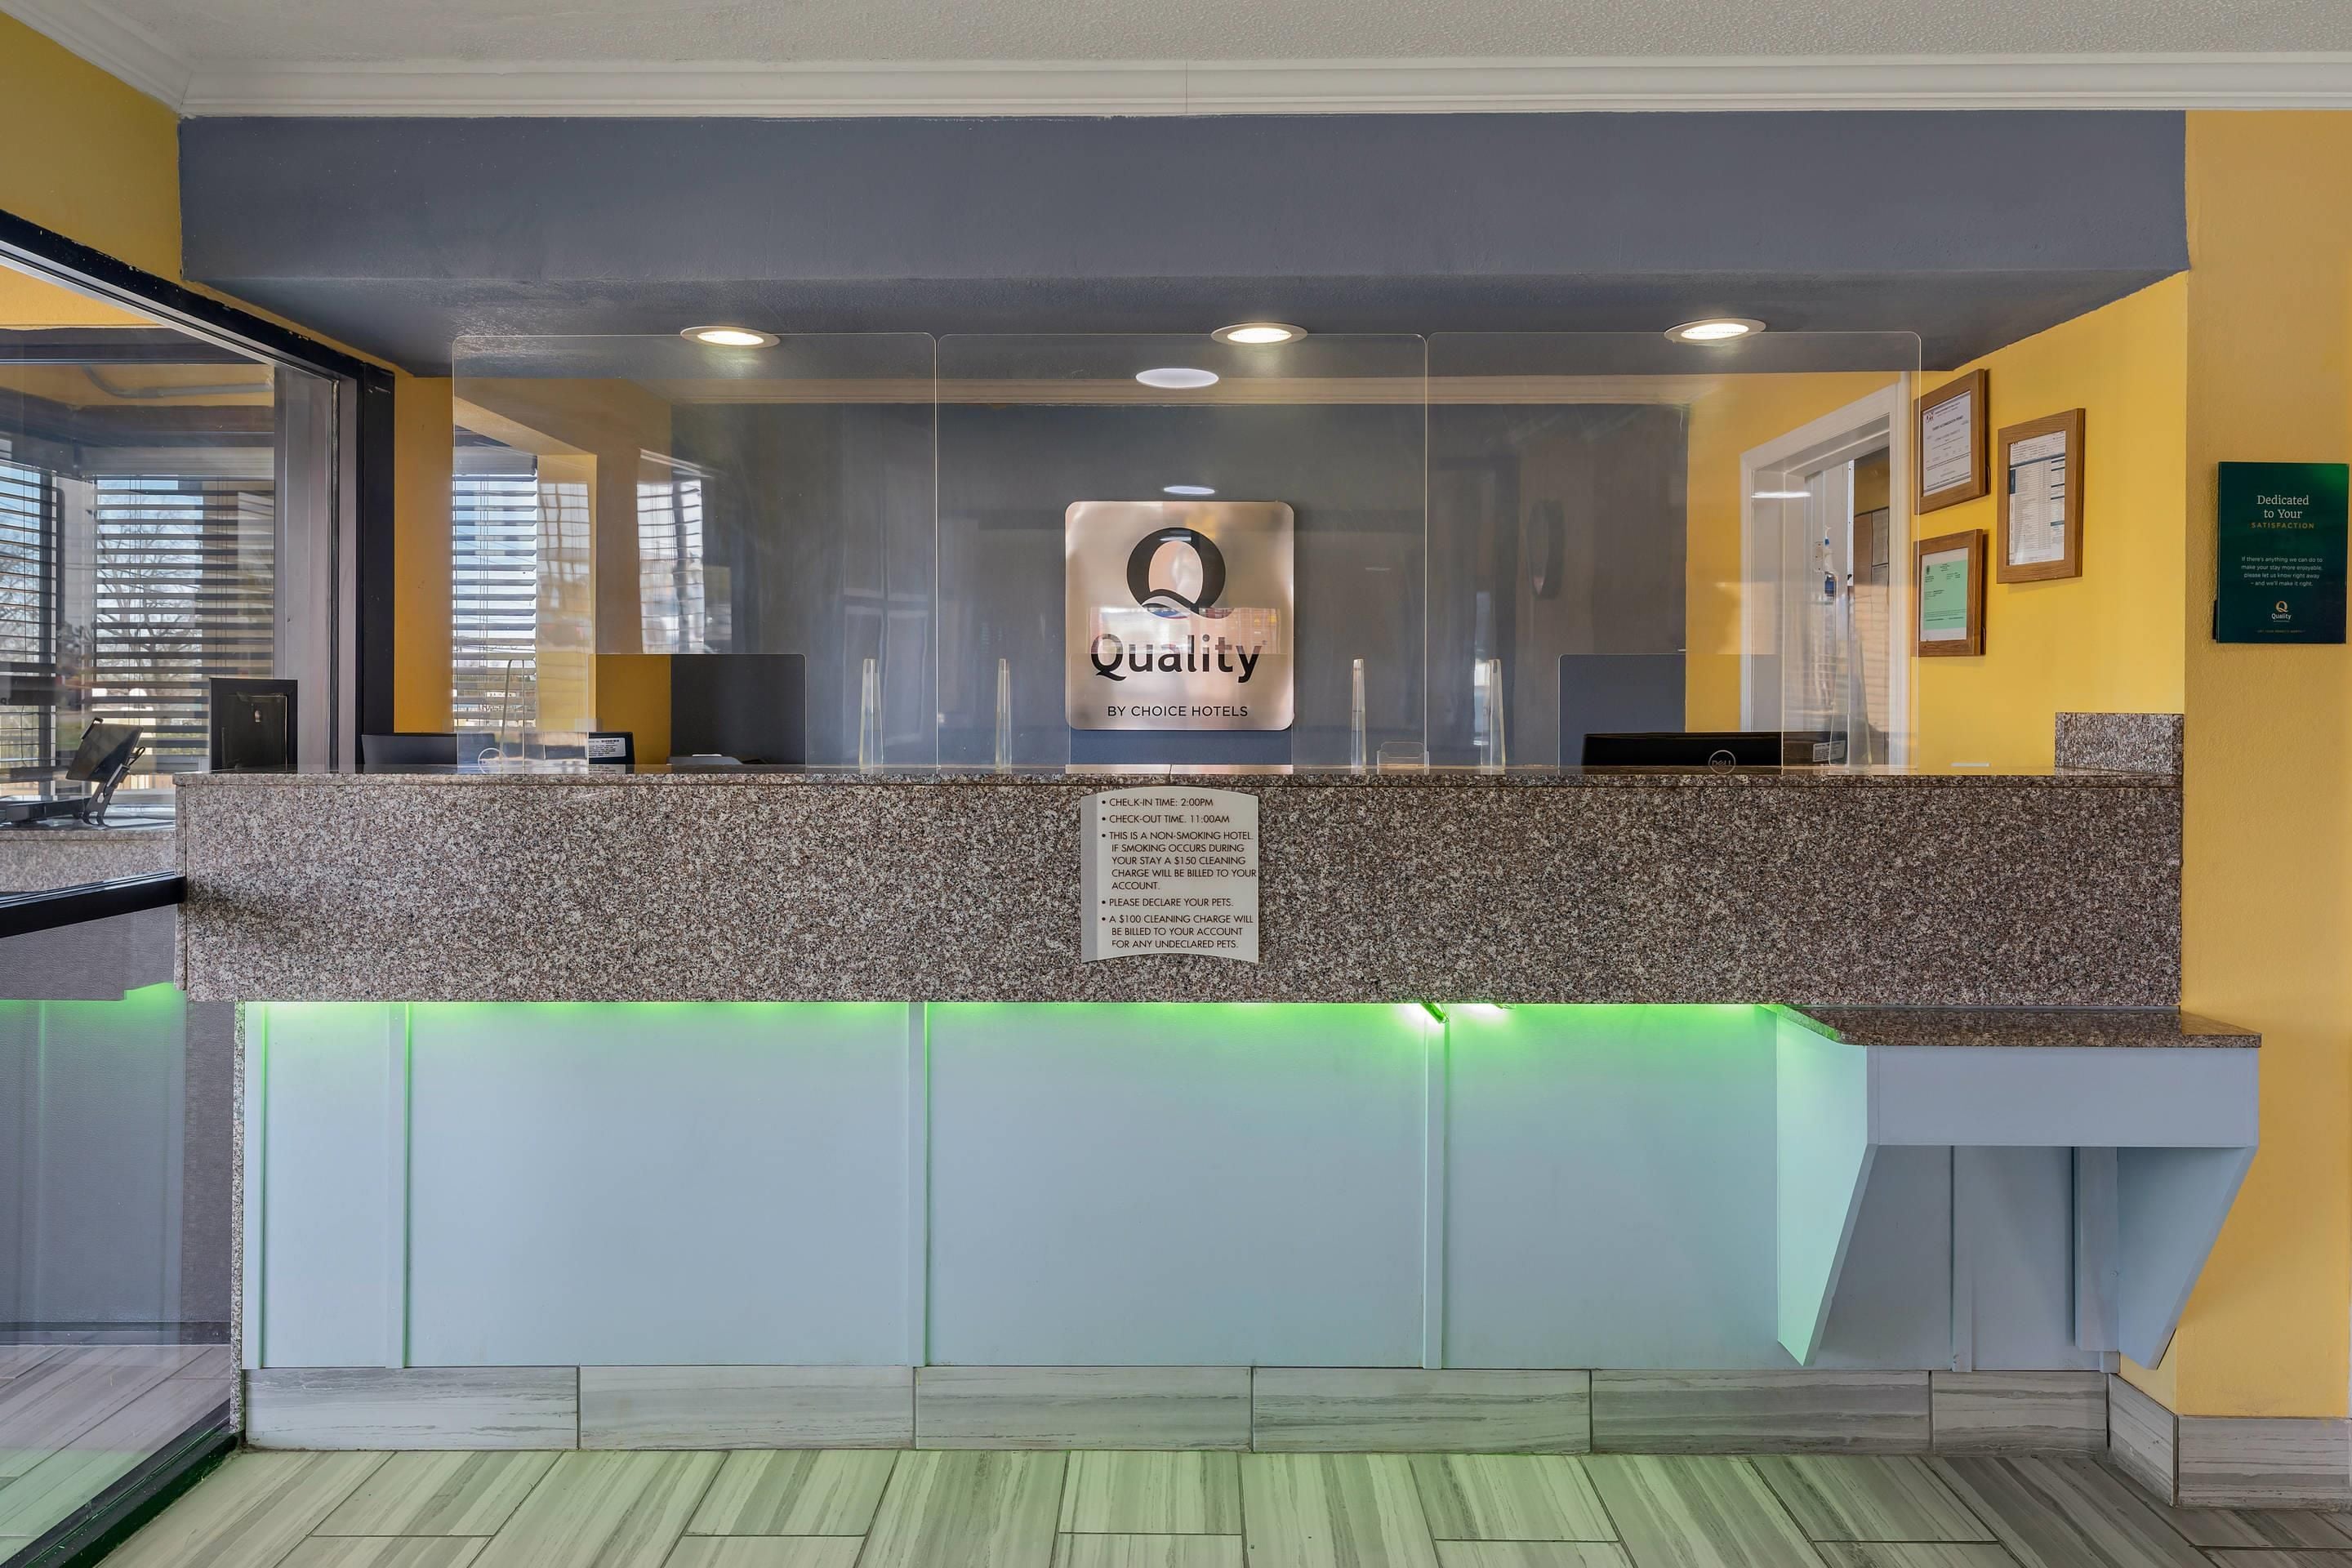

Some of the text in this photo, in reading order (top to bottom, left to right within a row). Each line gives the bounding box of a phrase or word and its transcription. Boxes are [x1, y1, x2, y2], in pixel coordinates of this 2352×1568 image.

[2256, 495, 2310, 506] Dedicated
[2264, 509, 2302, 519] to Your
[1127, 528, 1235, 619] Q
[2275, 600, 2289, 612] Q
[1091, 634, 1263, 683] Quality
[1107, 706, 1248, 717] BY CHOICE HOTELS
[1109, 798, 1213, 806] CHECK-IN TIME: 2:00PM
[1109, 814, 1161, 823] CHECK-OUT
[1191, 814, 1230, 823] 11:00AM
[1109, 831, 1129, 840] THIS
[1130, 831, 1138, 840] IS
[1140, 831, 1148, 840] A
[1150, 831, 1221, 840] NON-SMOKING
[1111, 844, 1245, 853] IF SMOKING OCCURS DURING
[1111, 857, 1246, 865] YOUR STAY A $150 CLEANING
[1111, 869, 1257, 877] CHARGE WILL BE BILLED TO YOUR
[1111, 881, 1160, 890] ACCOUNT.
[1109, 898, 1234, 906] PLEASE DECLARE YOUR PETS.
[1109, 915, 1254, 924] A $100 CLEANING CHARGE WILL
[1111, 927, 1243, 936] BE BILLED TO YOUR ACCOUNT
[1111, 940, 1239, 948] FOR ANY UNDECLARED PETS.
